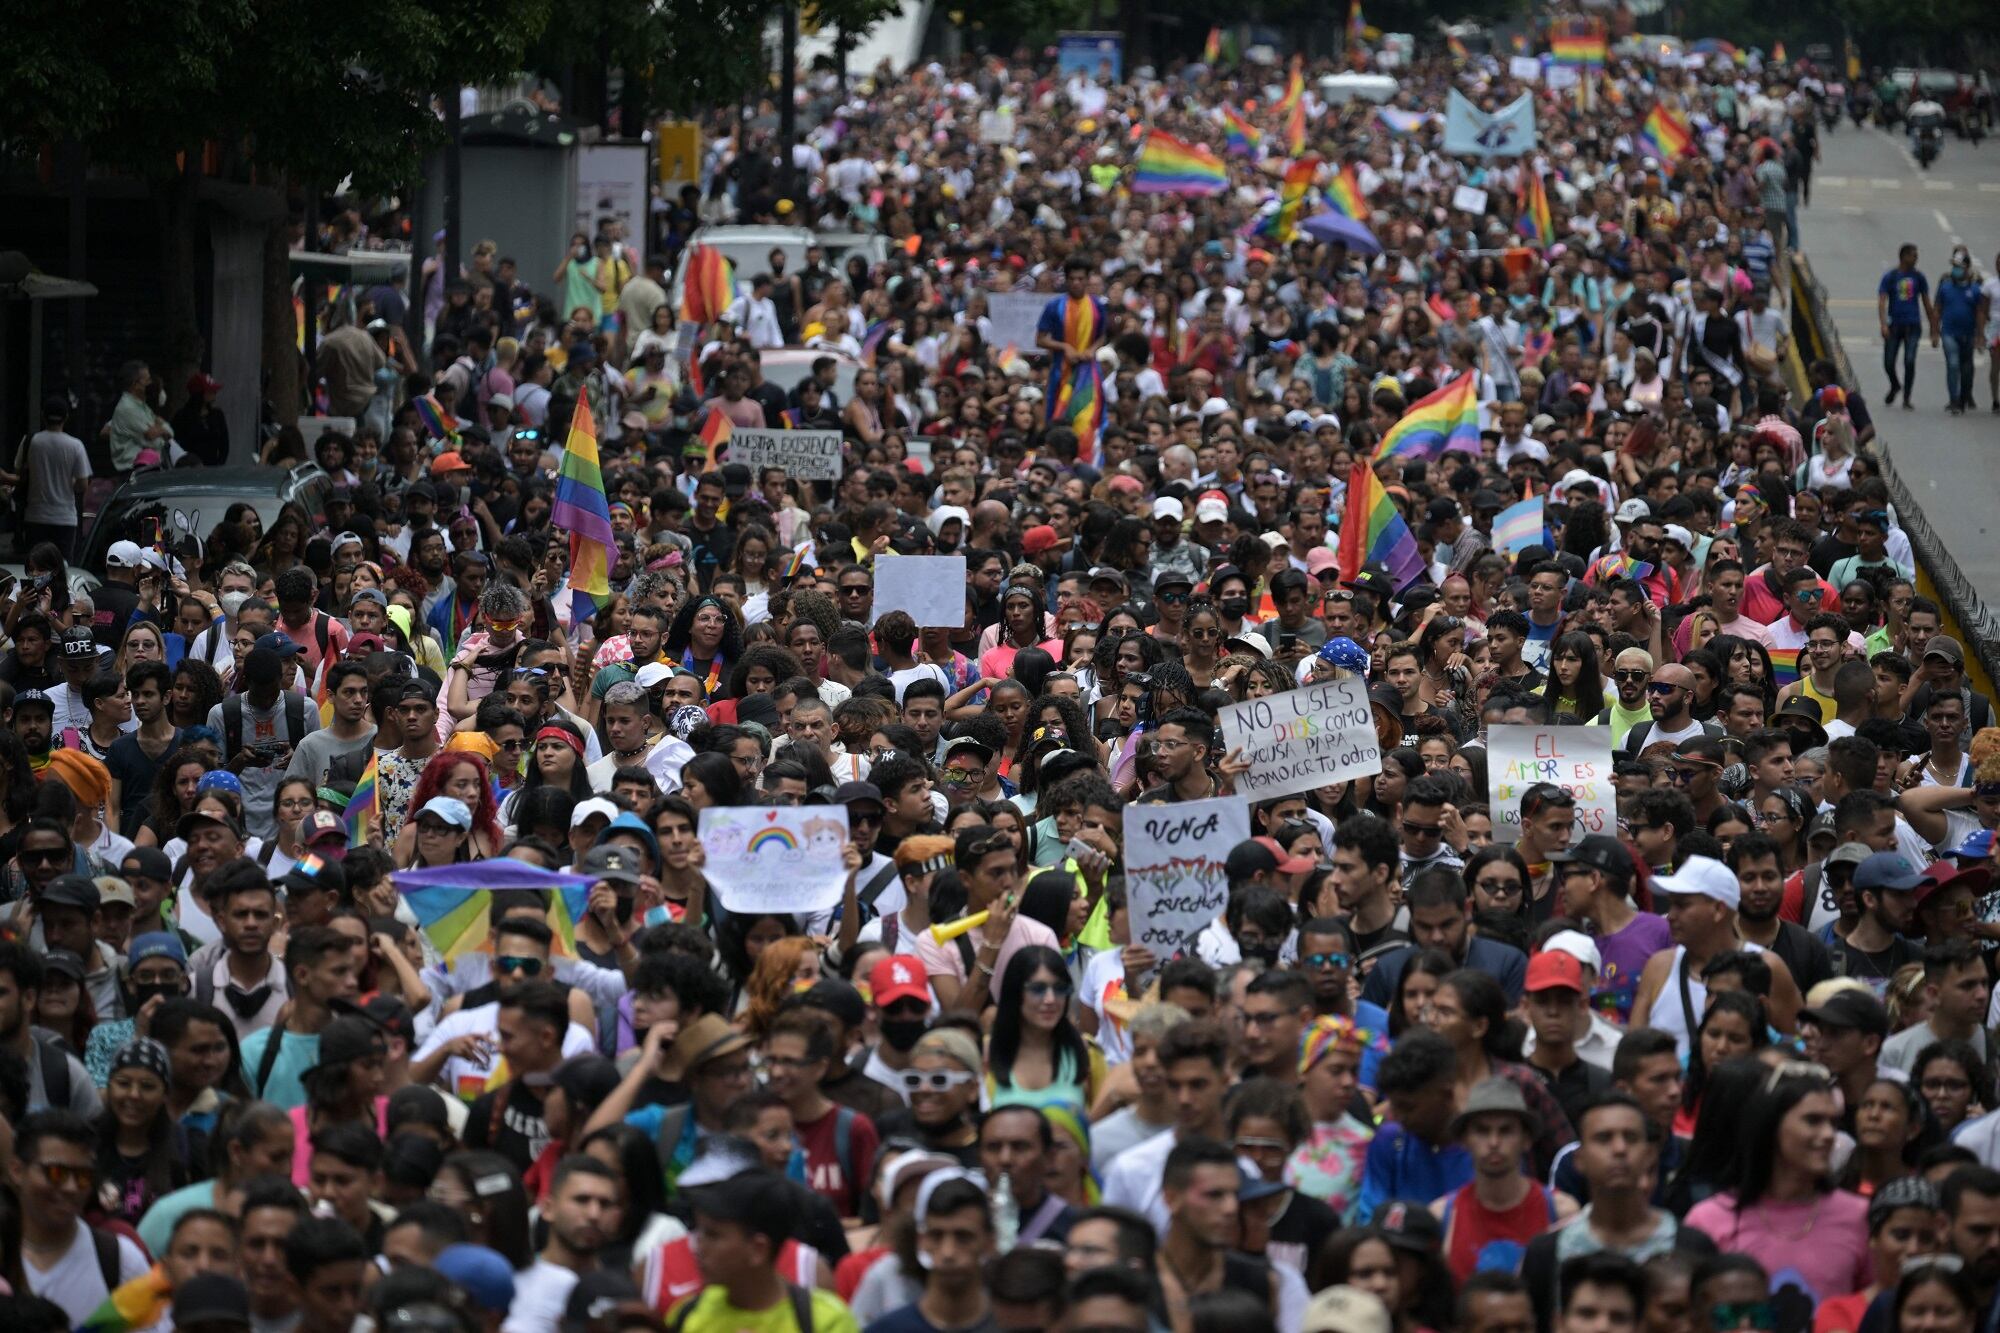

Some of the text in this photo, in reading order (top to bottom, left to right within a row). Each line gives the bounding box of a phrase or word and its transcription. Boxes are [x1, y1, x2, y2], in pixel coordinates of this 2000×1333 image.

[731, 434, 840, 455] NUESTRA EXISTENCIA
[64, 640, 92, 654] DOPE
[1235, 682, 1354, 734] NO USES
[1273, 714, 1320, 743] DIOS
[1325, 707, 1369, 732] COMO
[1305, 732, 1348, 755] PARA
[1535, 734, 1565, 758] EL
[1504, 759, 1595, 781] AMOR ES
[1498, 783, 1517, 801] DE
[1144, 812, 1220, 844] UNA
[1500, 809, 1520, 825] LOS
[1147, 893, 1224, 919] LUCHA
